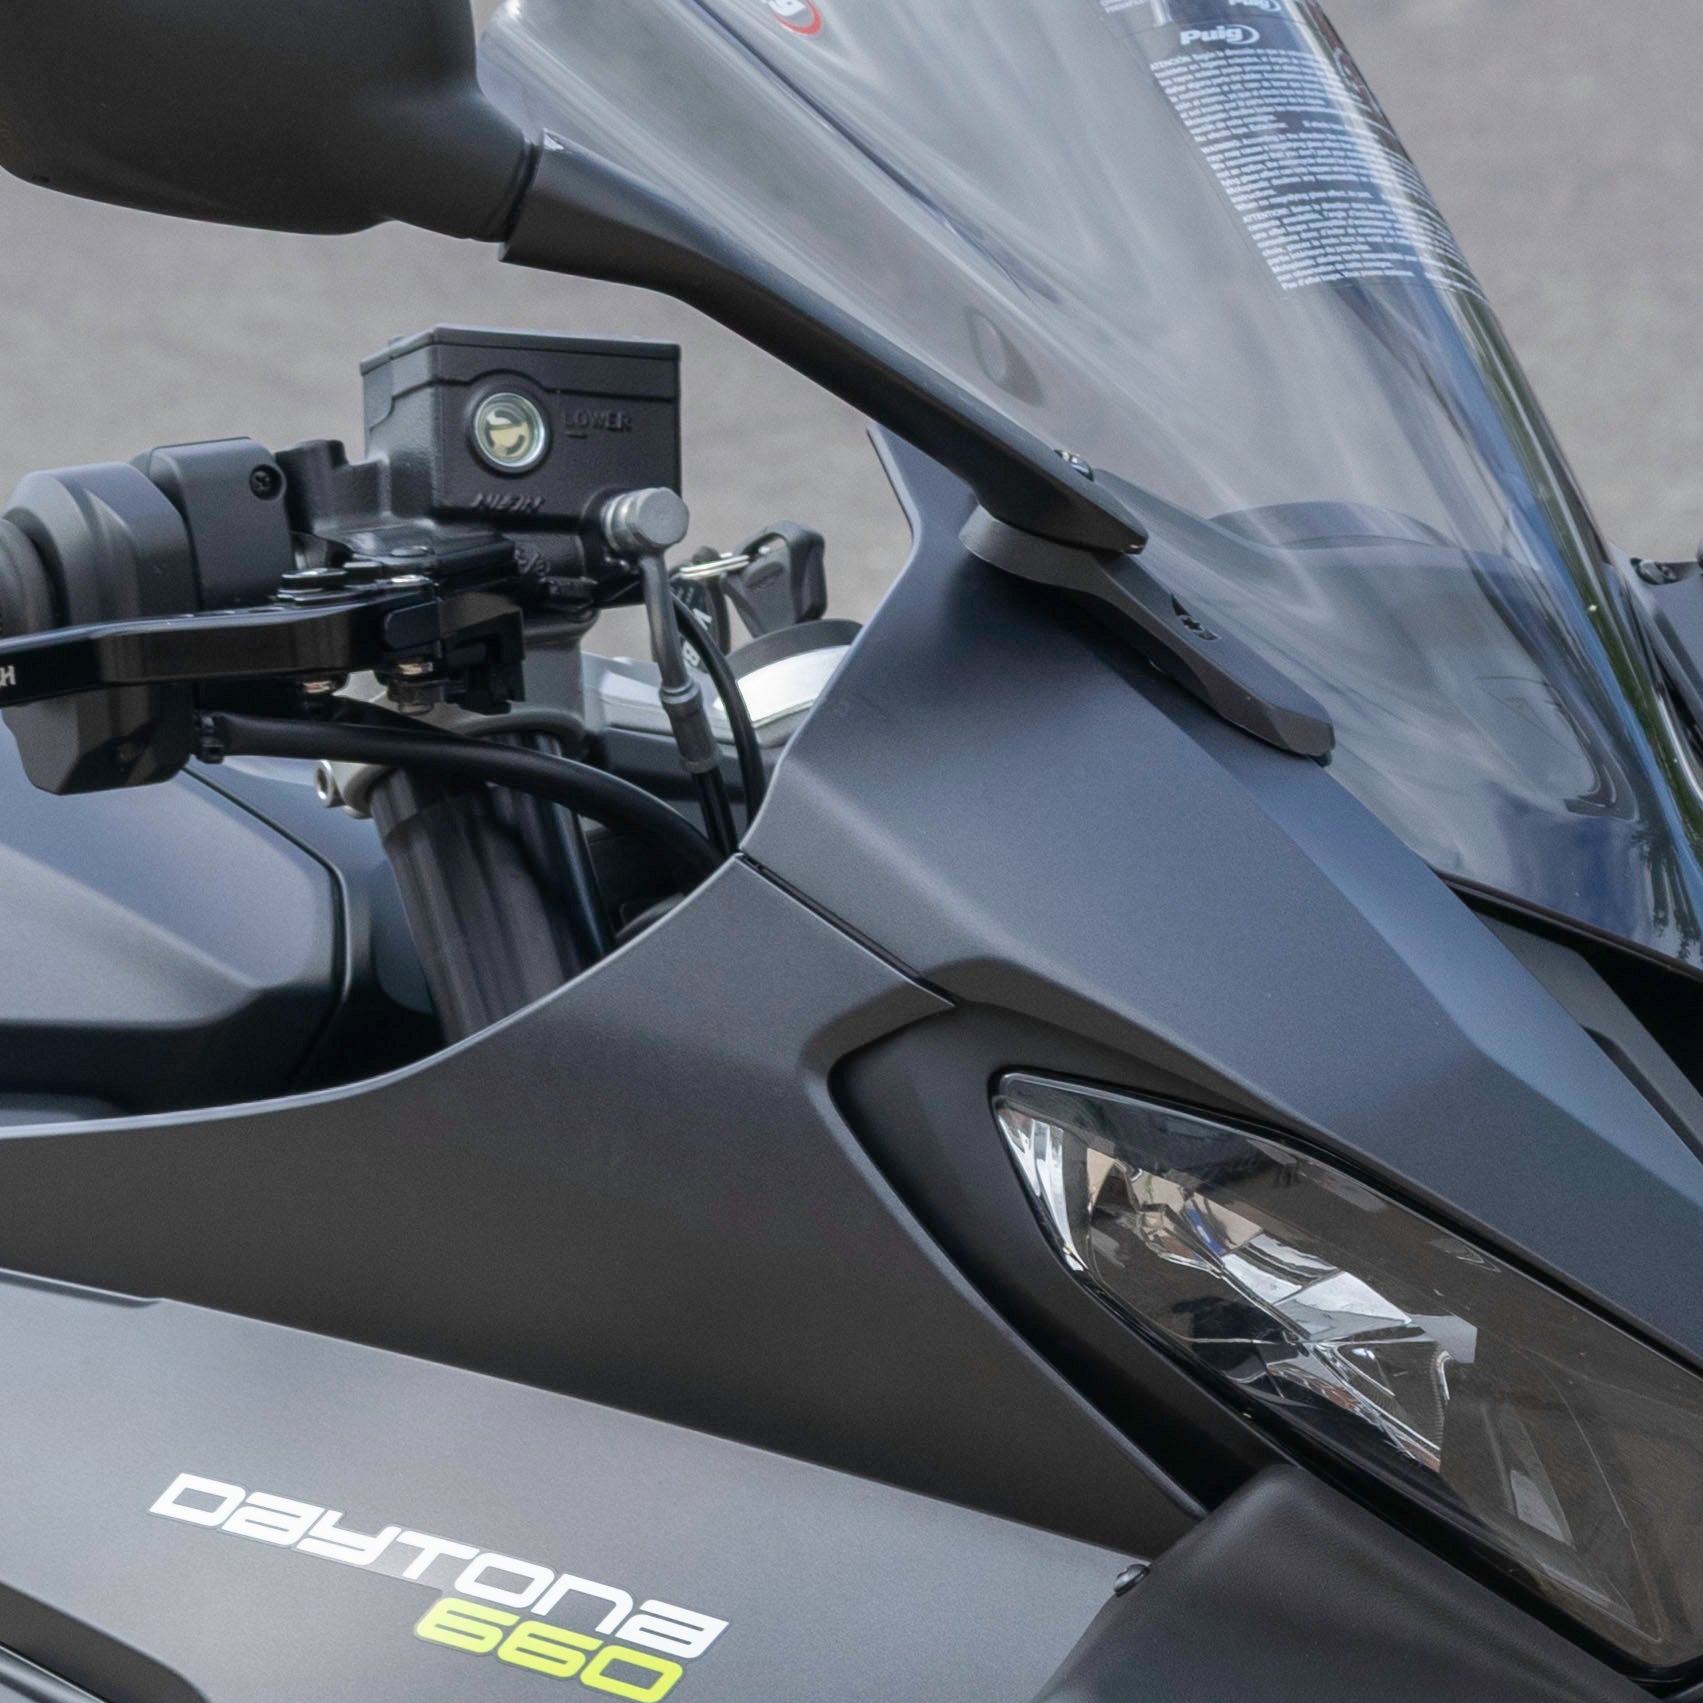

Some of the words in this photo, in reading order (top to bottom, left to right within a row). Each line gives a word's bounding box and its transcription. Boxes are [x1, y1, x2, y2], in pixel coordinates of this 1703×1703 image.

[1180, 24, 1260, 46] Puig
[561, 408, 633, 433] LOWER
[149, 1473, 729, 1659] DAYTONA
[416, 1597, 684, 1703] 660
